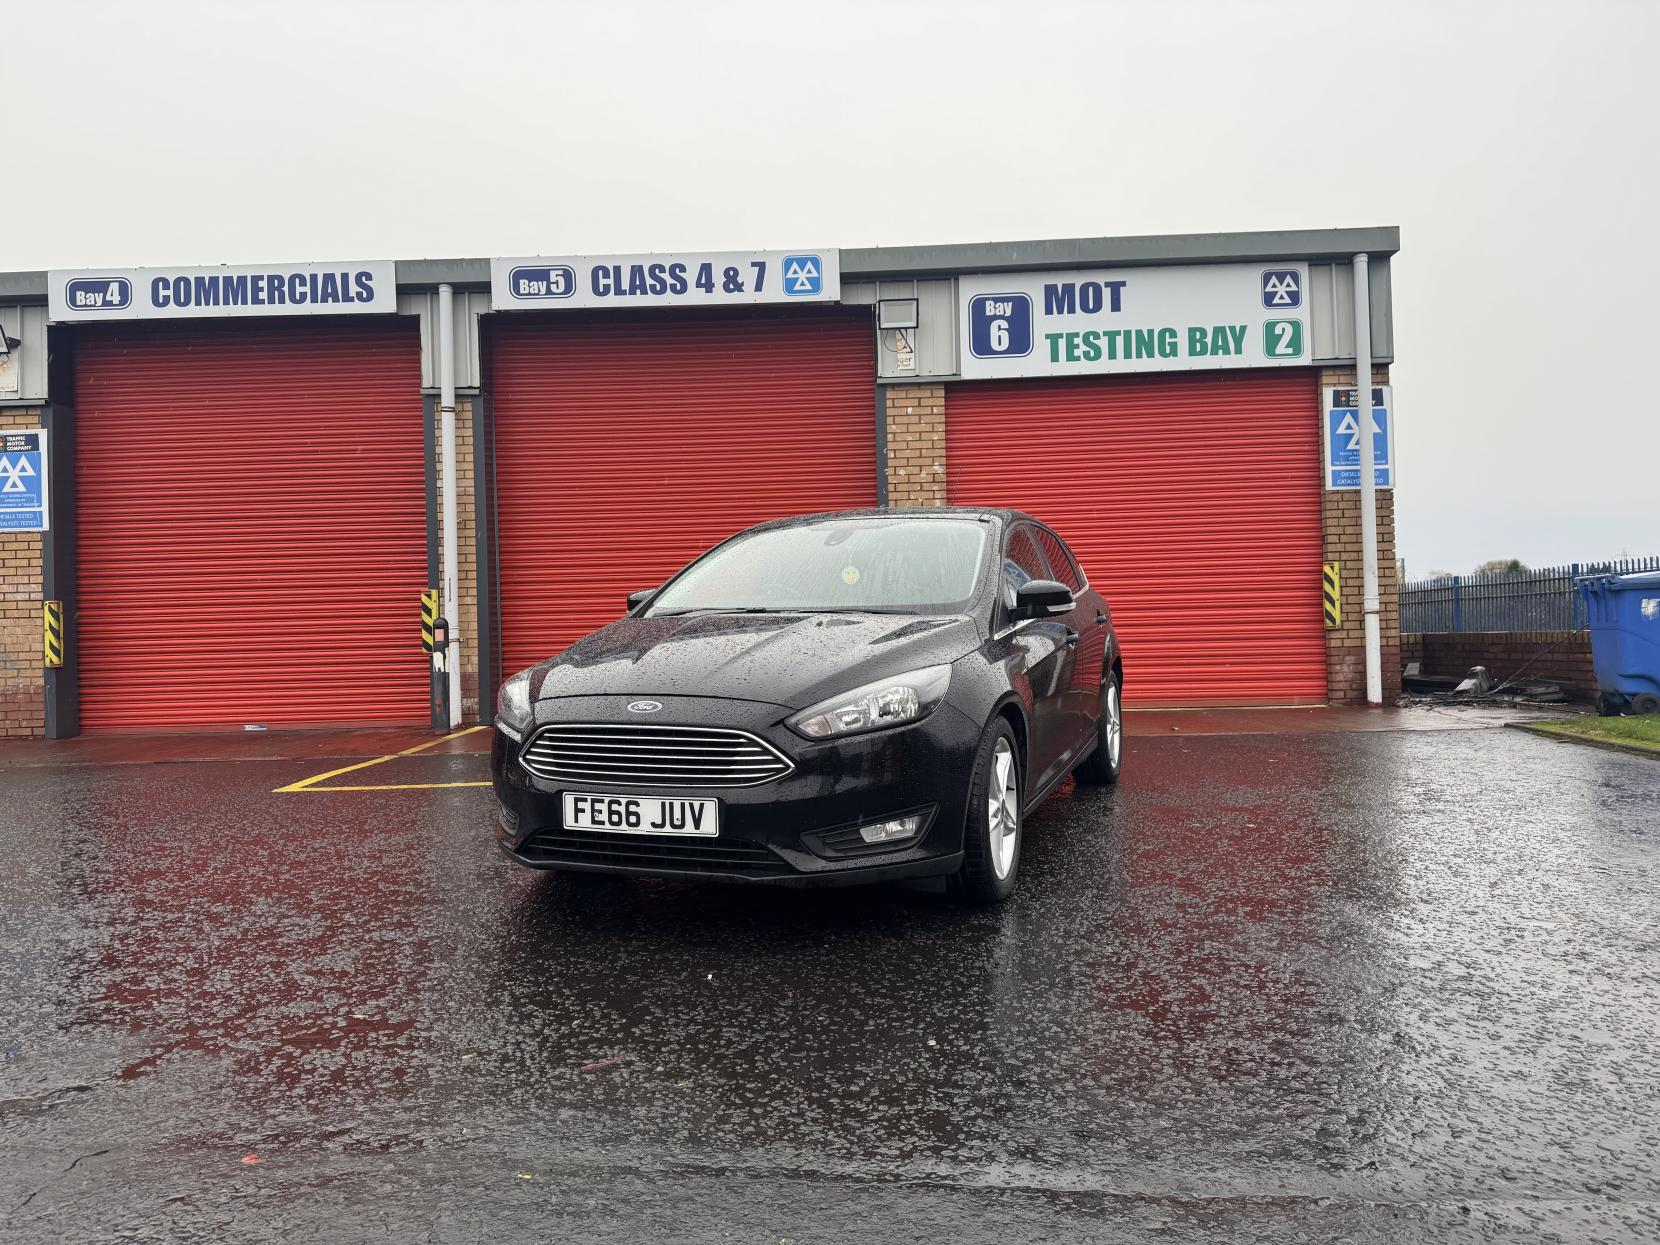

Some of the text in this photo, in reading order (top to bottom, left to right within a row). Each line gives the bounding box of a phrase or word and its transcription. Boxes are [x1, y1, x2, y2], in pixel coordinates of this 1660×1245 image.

[75, 281, 121, 306] Bay 4
[151, 271, 375, 308] COMMERCIALS
[519, 270, 566, 295] Bay 5
[591, 261, 767, 297] CLASS 4 & 7
[985, 300, 1013, 316] Bay
[1044, 280, 1127, 316] MOT
[990, 319, 1010, 352] 6
[1045, 325, 1248, 363] TESTING BAY
[1274, 322, 1294, 355] 2
[573, 796, 705, 831] FE66 JUV
